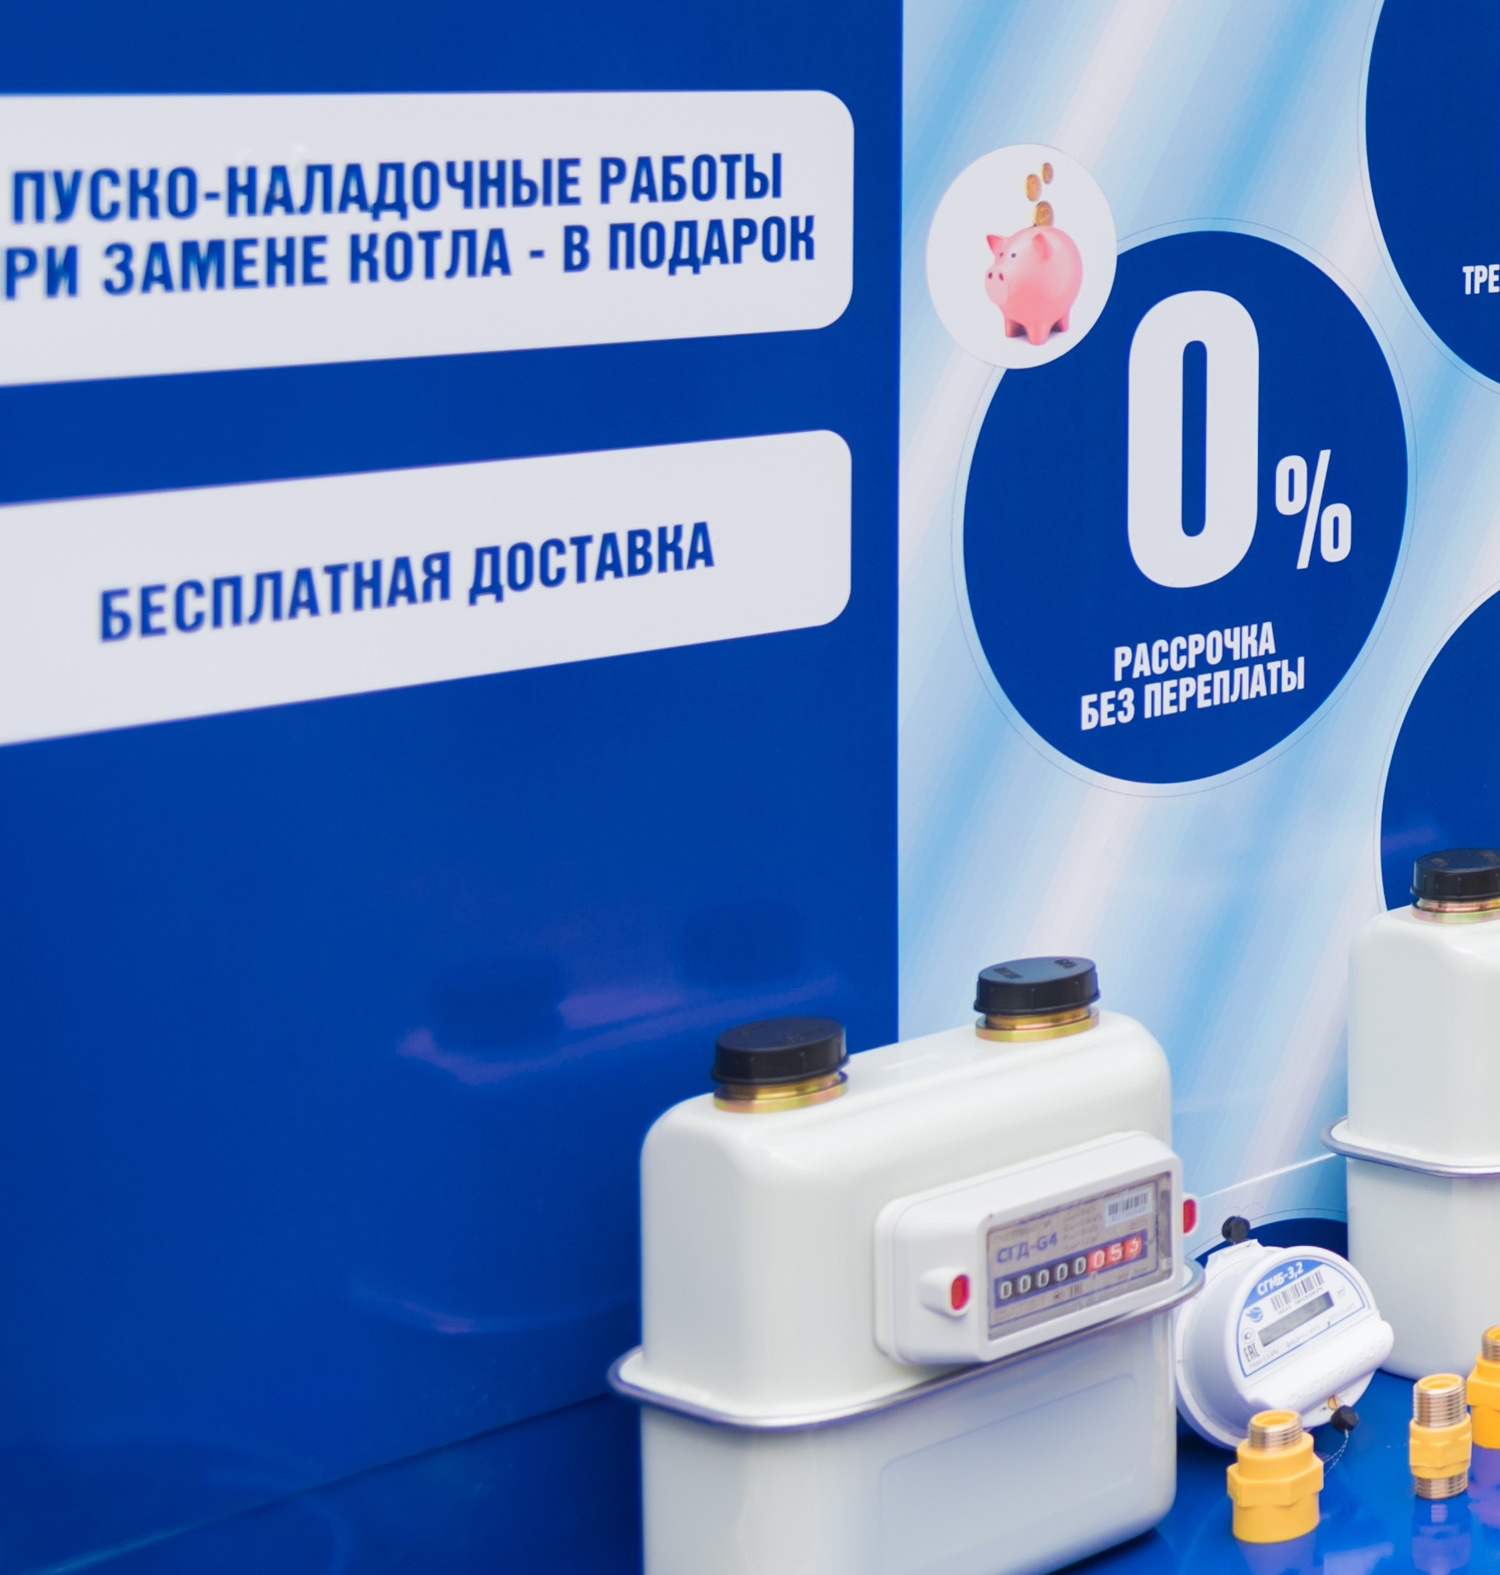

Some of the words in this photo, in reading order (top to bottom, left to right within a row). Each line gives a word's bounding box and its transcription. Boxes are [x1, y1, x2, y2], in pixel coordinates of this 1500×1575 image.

[12, 157, 582, 224] ПУСКО-НАЛАДОЧНЫЕ
[600, 152, 784, 205] РАБОТЫ
[102, 233, 329, 297] ЗАМЕНЕ
[349, 228, 512, 284] КОТЛА
[562, 225, 590, 274] В
[607, 214, 817, 277] ПОДАРОК
[100, 551, 452, 644] БЕСПЛАТНАЯ
[468, 520, 717, 607] ДОСТАВКА
[1113, 622, 1277, 682] РАССРОЧКА
[1080, 691, 1137, 731] БЕЗ
[1143, 656, 1306, 719] ПЕРЕПЛАТЫ
